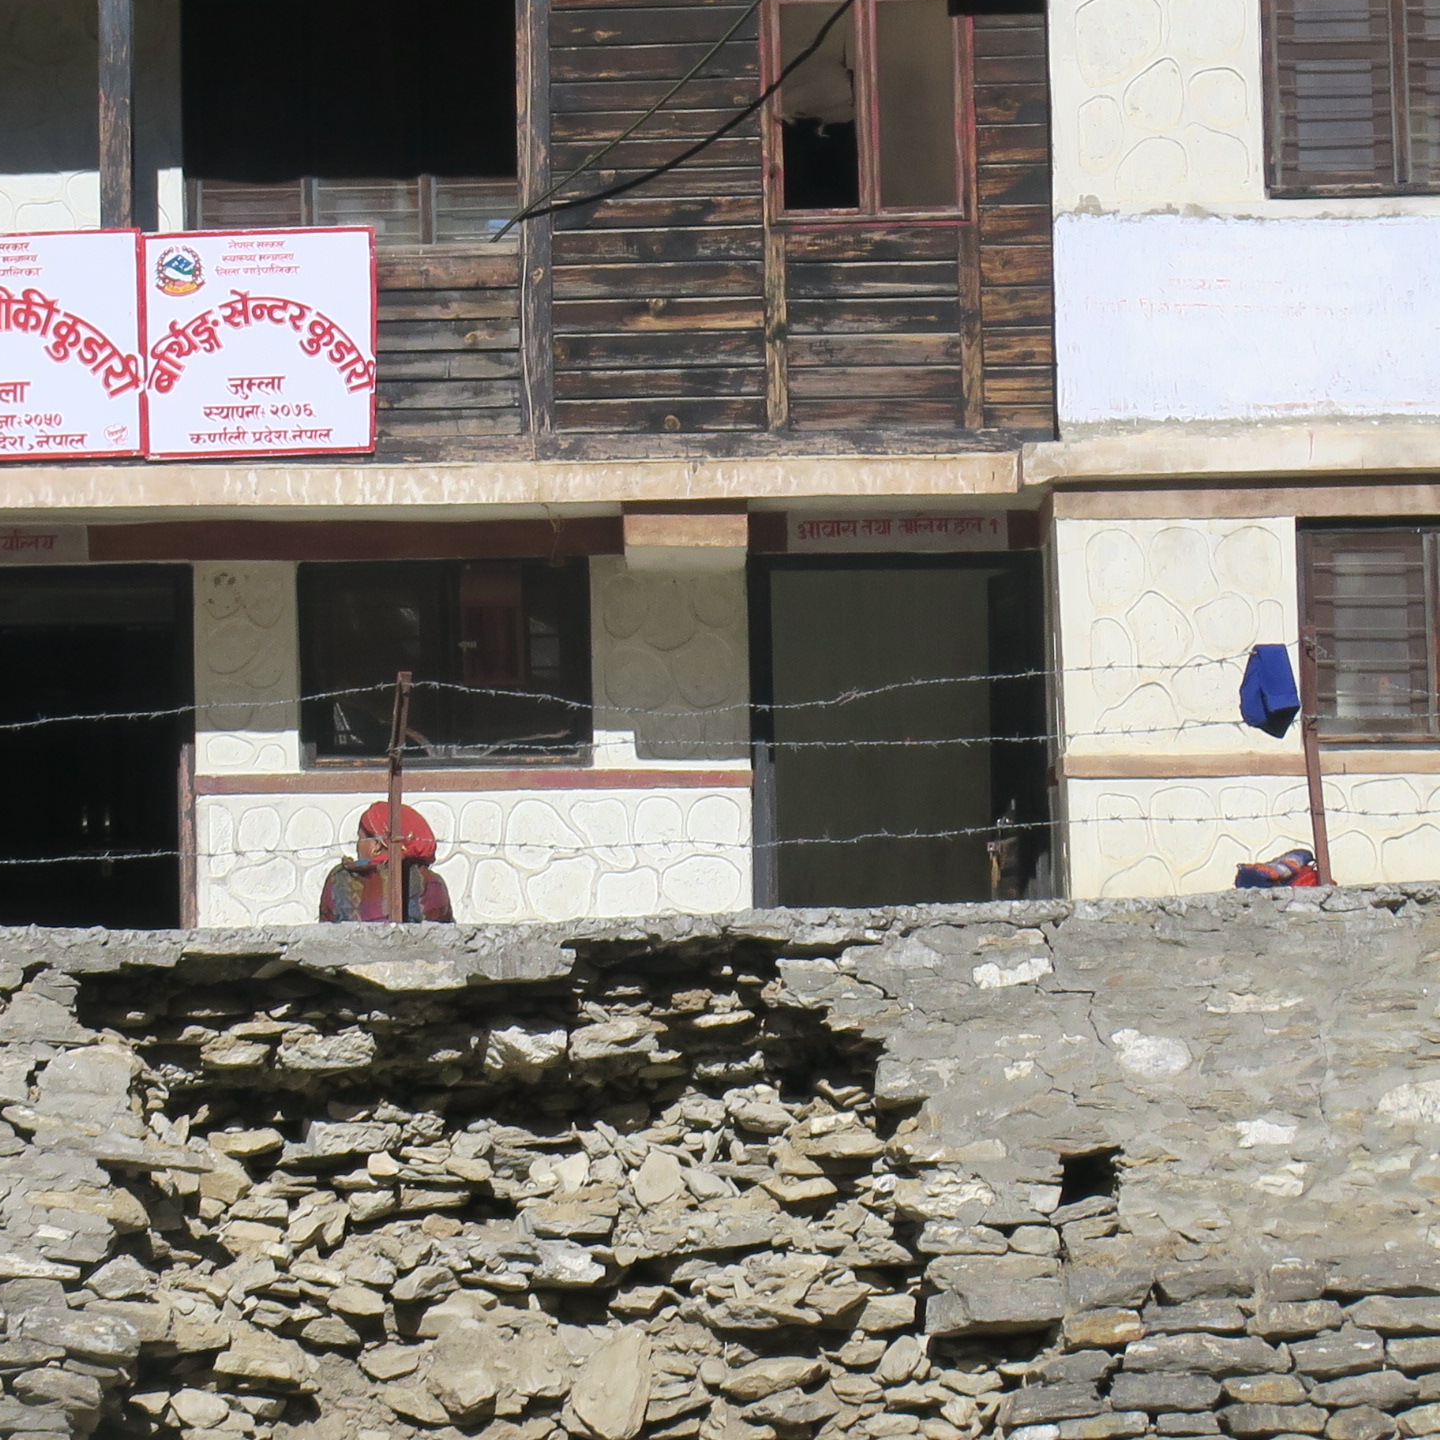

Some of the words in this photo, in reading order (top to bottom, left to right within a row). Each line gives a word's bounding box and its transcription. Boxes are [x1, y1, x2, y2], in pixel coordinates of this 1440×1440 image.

[218, 289, 314, 333] सेन्टर
[299, 311, 377, 394] कुडारी
[44, 311, 142, 398] कुडारी
[226, 375, 287, 400] जुम्ला
[34, 429, 88, 449] नेपाल
[189, 425, 249, 445] कर्णाली
